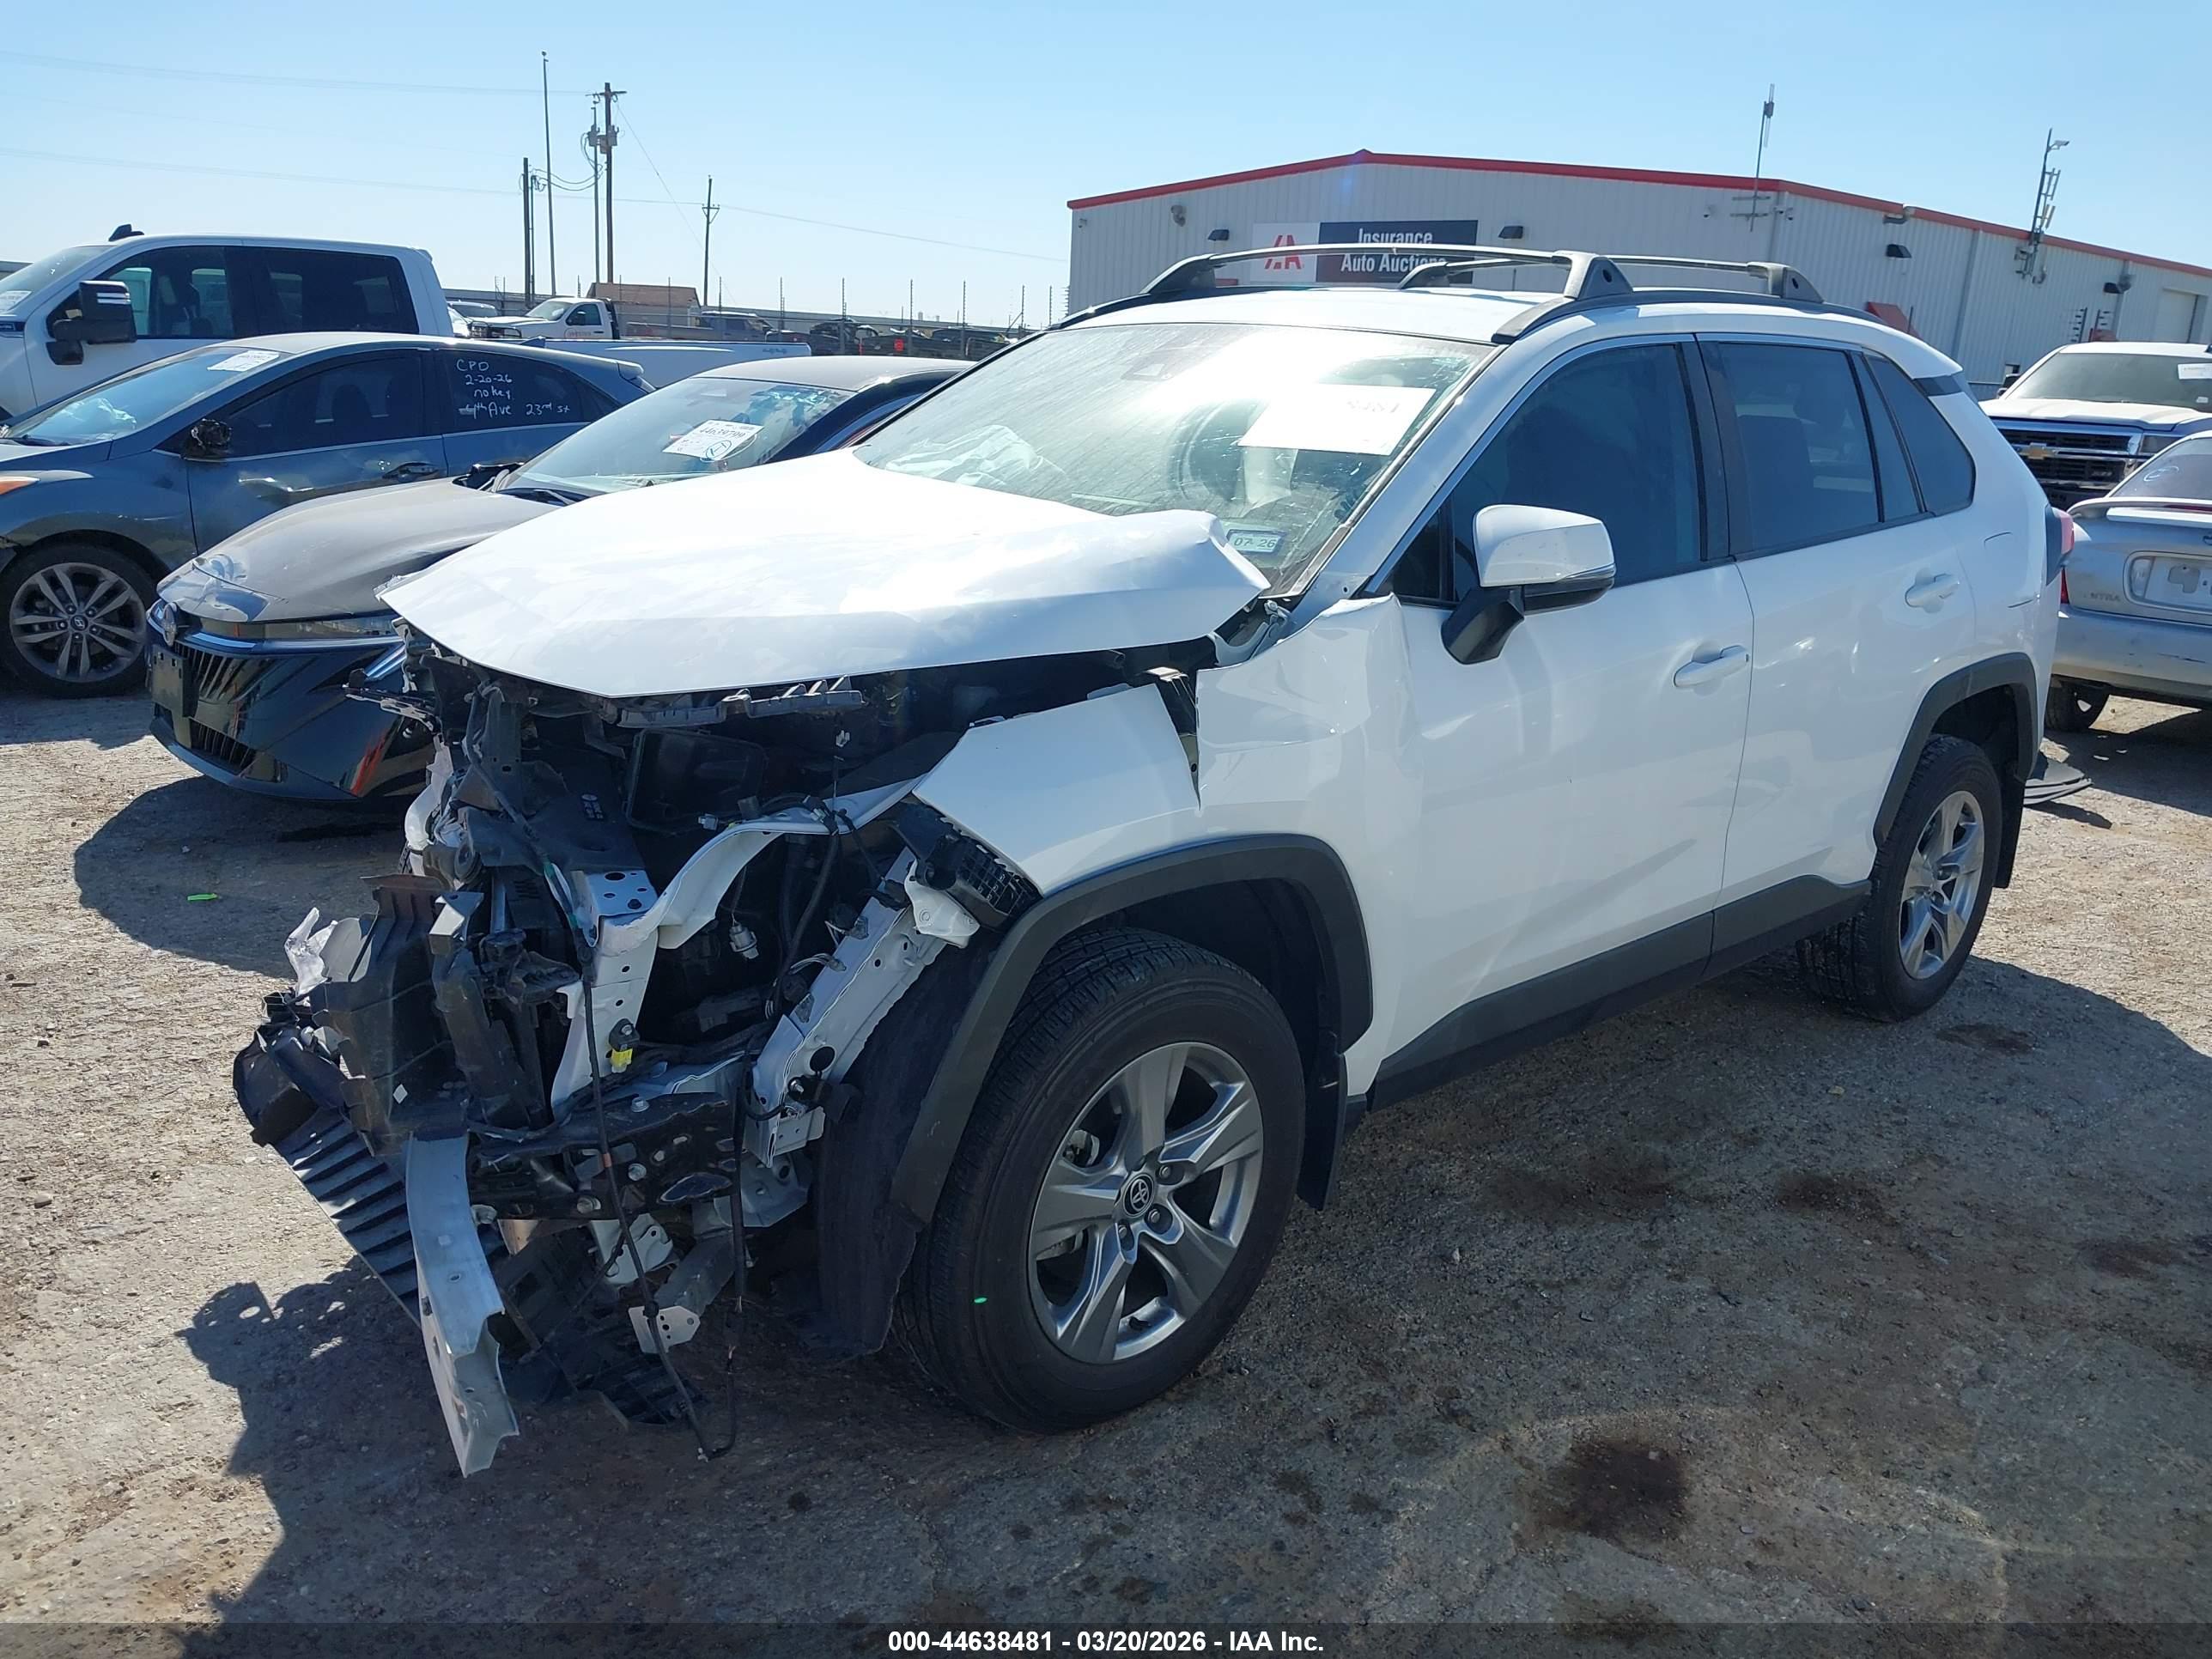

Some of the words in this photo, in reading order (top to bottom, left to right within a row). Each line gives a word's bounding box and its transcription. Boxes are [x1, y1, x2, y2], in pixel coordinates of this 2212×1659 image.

[1358, 228, 1433, 245] Insurance
[1340, 253, 1375, 272] Auto
[1378, 253, 1447, 272] Aucti
[465, 374, 513, 386] 2-20-26
[474, 389, 489, 398] no
[490, 386, 511, 399] key
[488, 401, 512, 418] Ave
